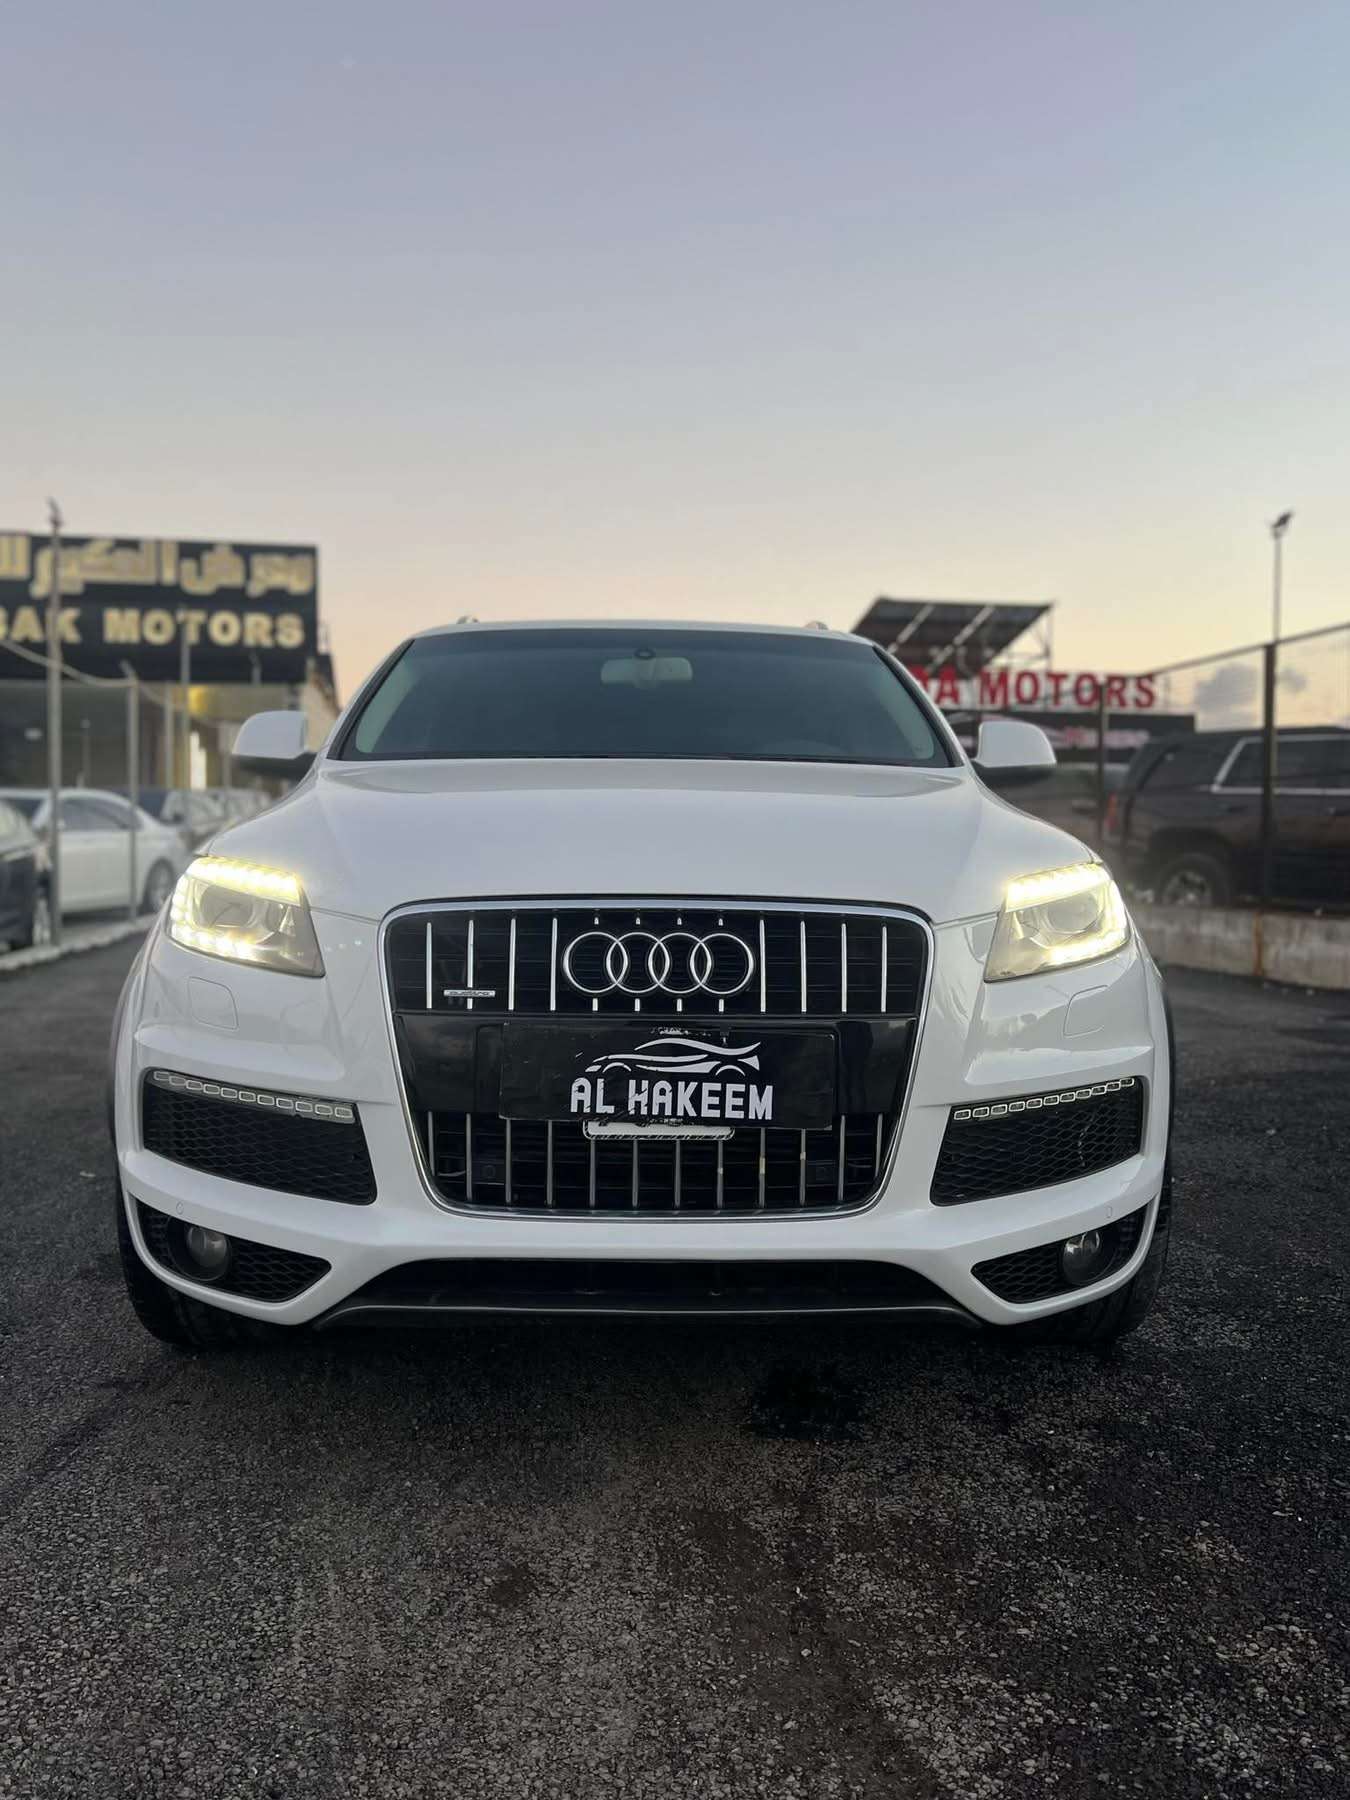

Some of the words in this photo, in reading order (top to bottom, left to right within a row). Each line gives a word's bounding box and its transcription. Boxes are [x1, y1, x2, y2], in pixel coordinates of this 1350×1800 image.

[0, 605, 81, 643] AK
[103, 607, 305, 648] MOTORS
[980, 667, 1157, 709] MOTORS
[570, 1077, 615, 1114] AL
[627, 1079, 774, 1121] HAKEEM
